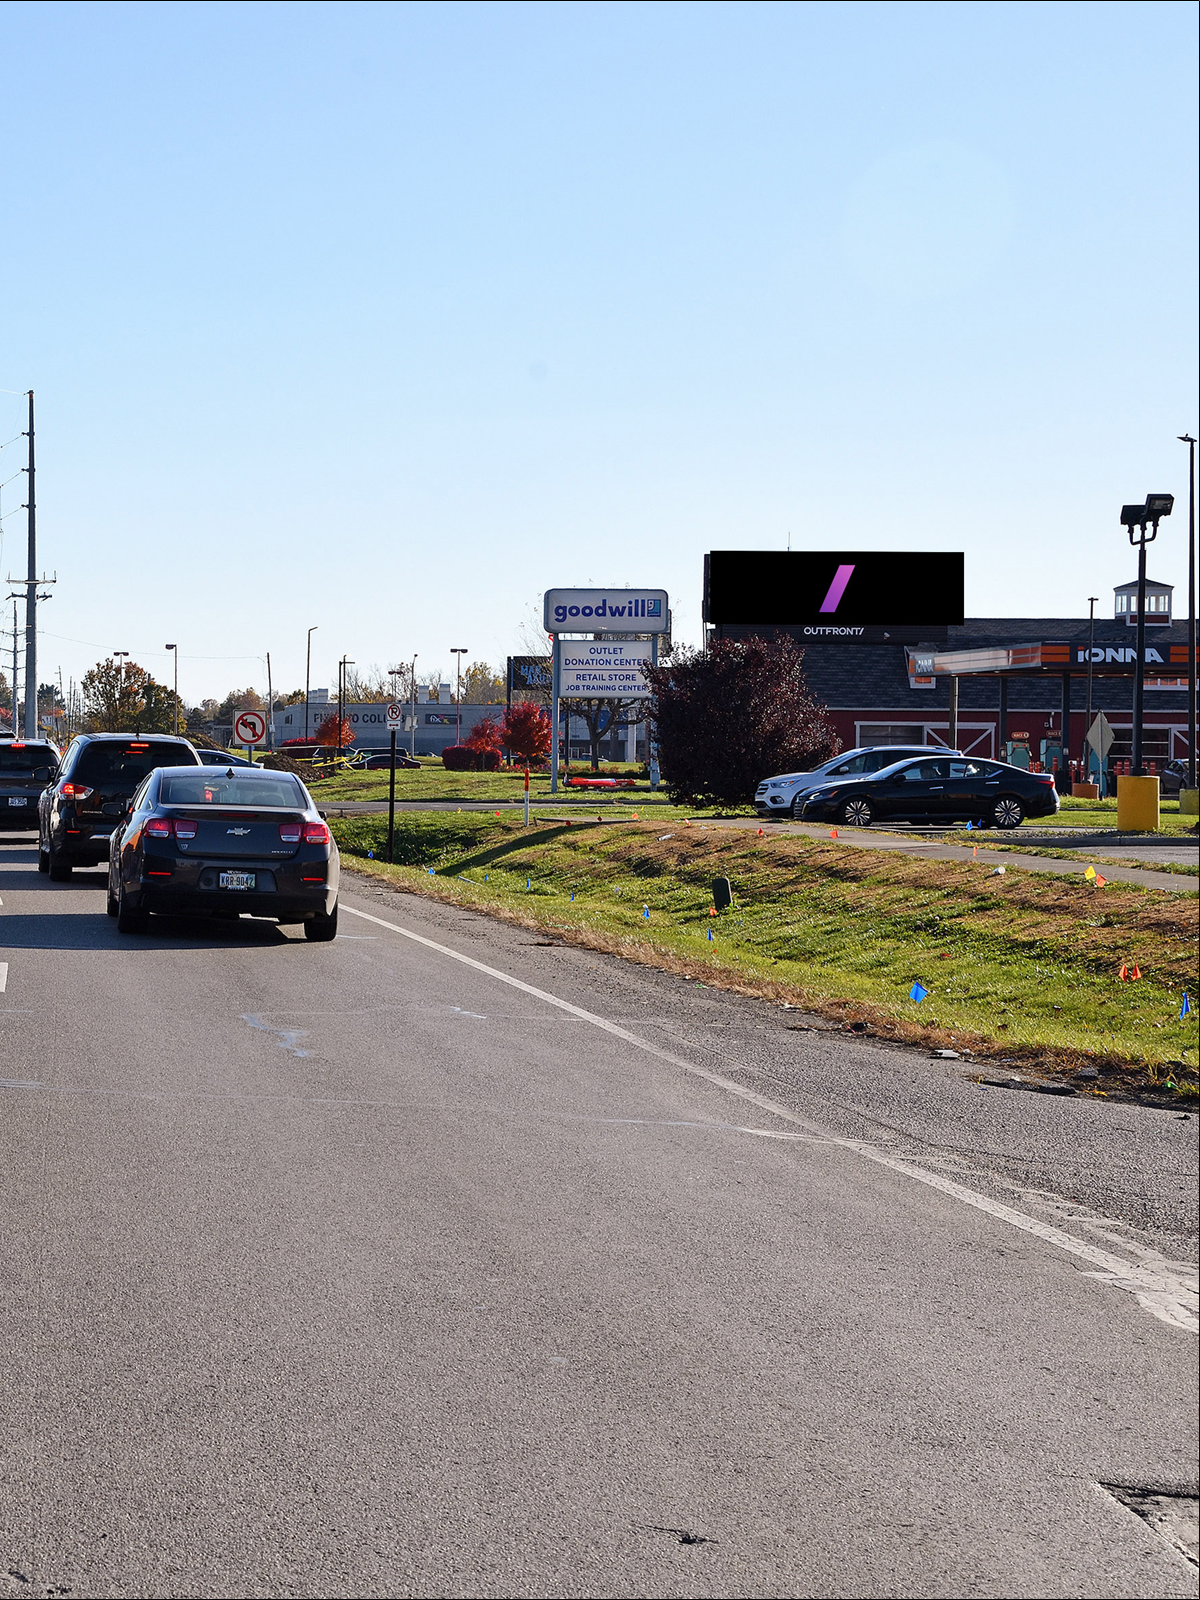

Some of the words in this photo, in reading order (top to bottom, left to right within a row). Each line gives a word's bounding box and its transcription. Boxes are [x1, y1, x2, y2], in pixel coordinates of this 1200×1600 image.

[554, 599, 646, 623] goodwill
[589, 647, 624, 655] OUTLET
[564, 658, 612, 666] DONATION
[575, 673, 606, 682] RETAIL
[608, 673, 637, 682] STORE
[565, 684, 580, 692] JOB
[581, 684, 616, 692] TRAINING
[617, 684, 647, 692] CENTER
